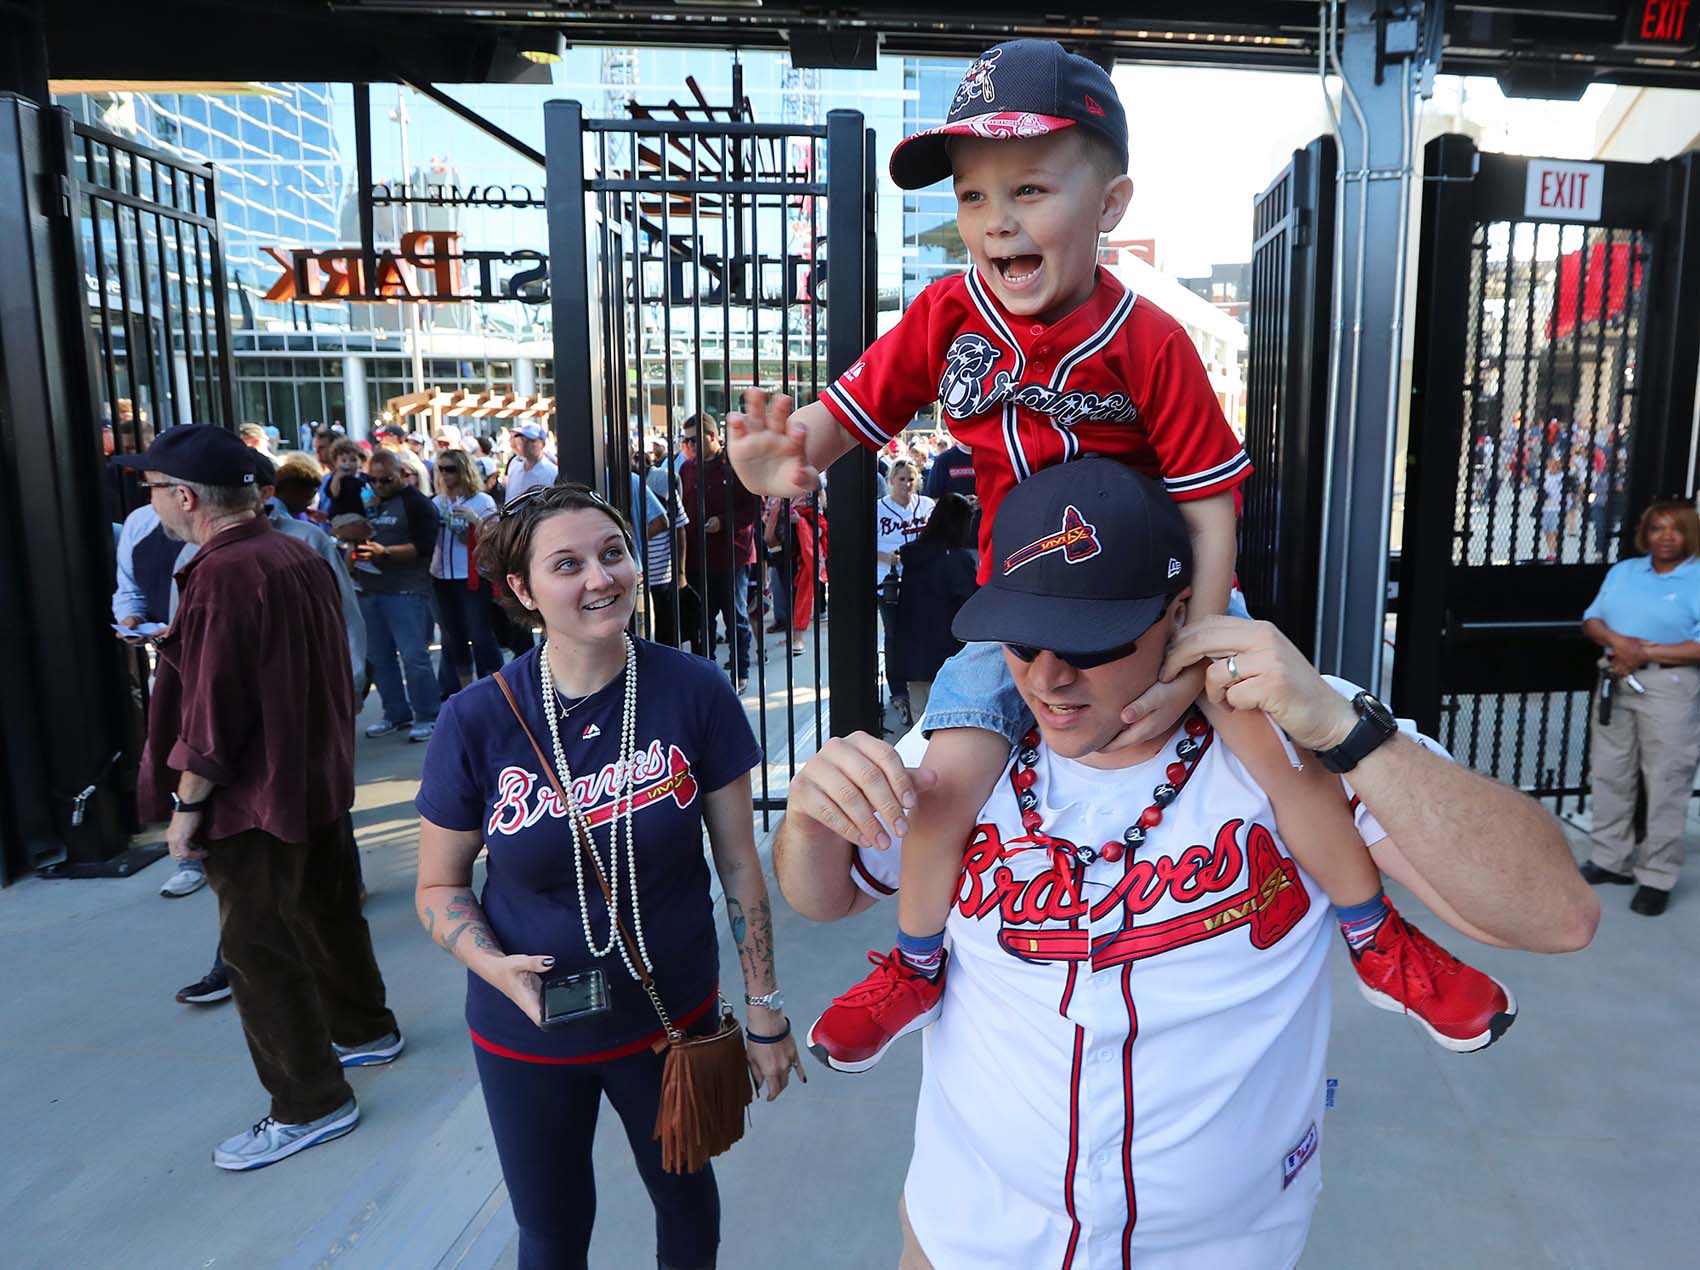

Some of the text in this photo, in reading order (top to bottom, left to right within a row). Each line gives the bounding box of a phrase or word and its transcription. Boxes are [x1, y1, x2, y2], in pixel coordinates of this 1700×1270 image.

[1640, 0, 1690, 40] EXIT
[1540, 171, 1590, 209] EXIT
[950, 818, 1245, 925] Braves
